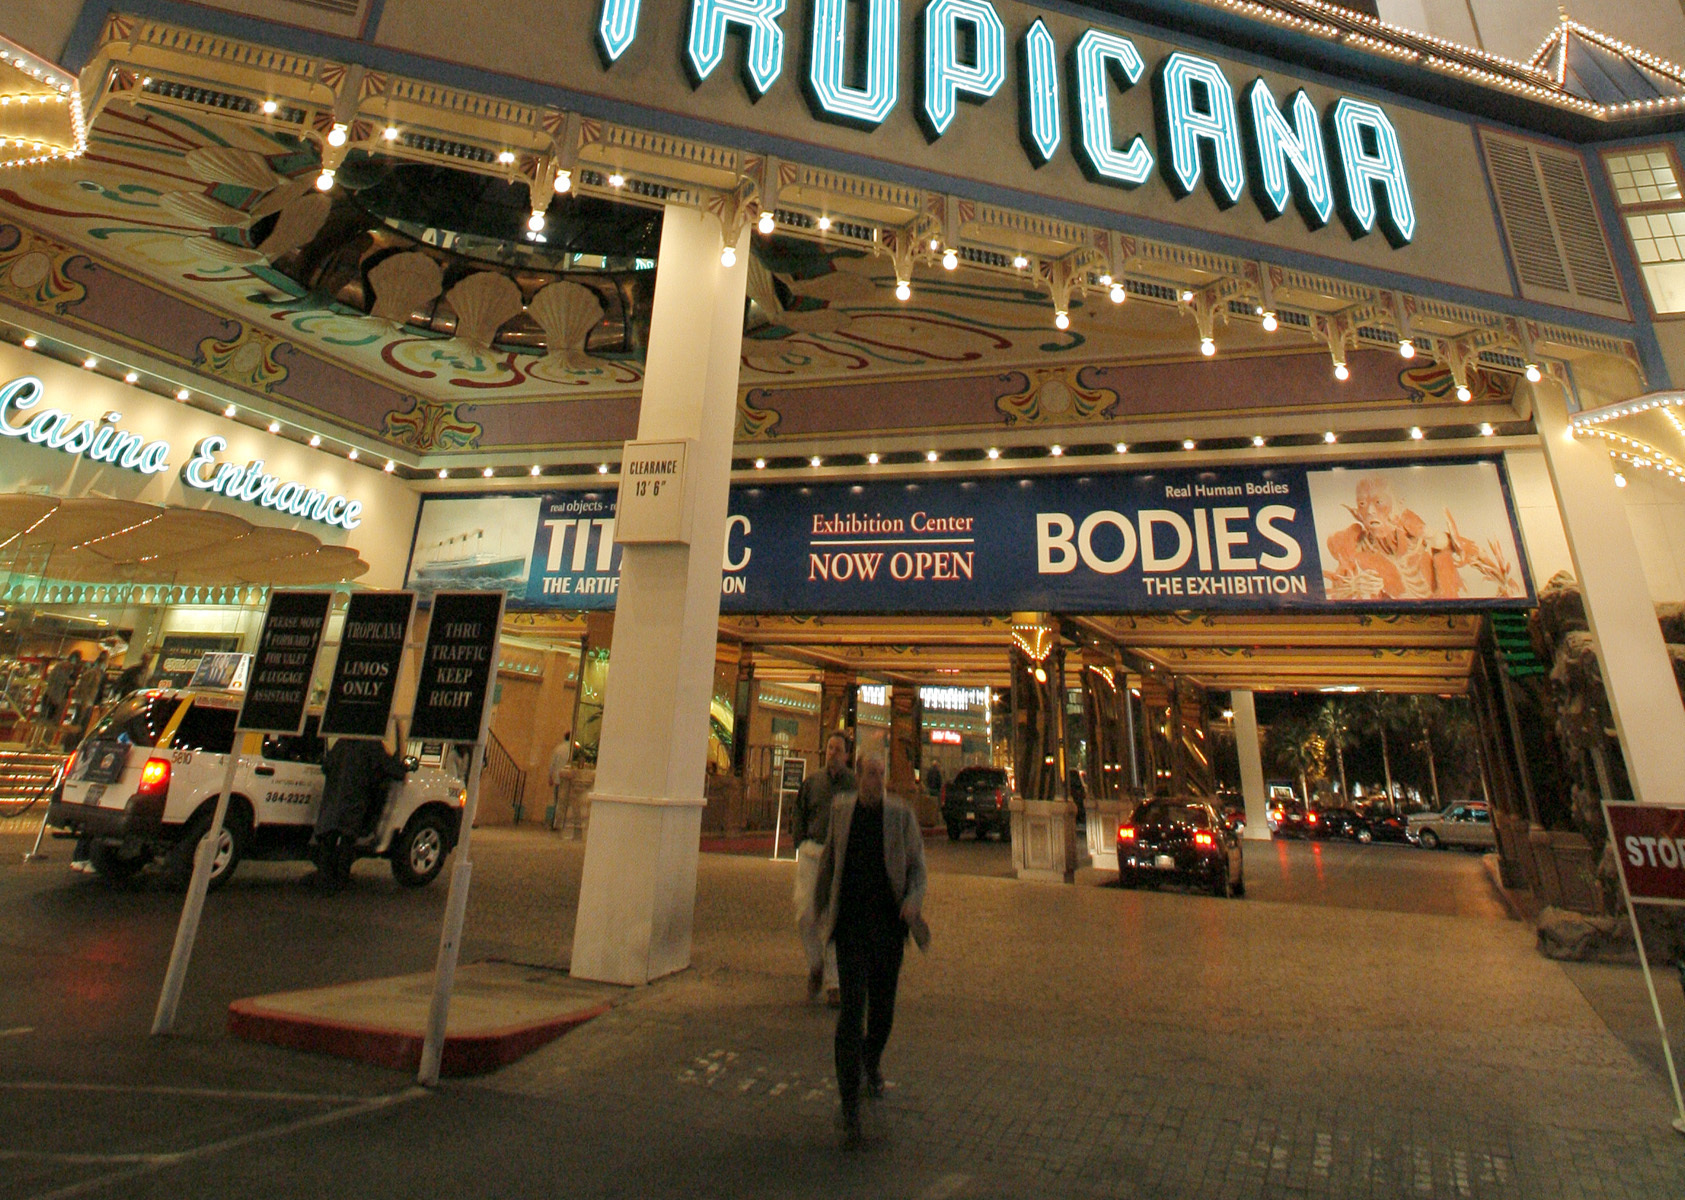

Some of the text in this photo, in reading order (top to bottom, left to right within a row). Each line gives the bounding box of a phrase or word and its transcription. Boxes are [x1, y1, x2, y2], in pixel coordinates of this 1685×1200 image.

[0, 375, 363, 530] Casino Entrance
[630, 460, 677, 475] CLEARANCE
[1165, 482, 1289, 498] Real Human Bodies
[550, 502, 566, 513] real
[566, 500, 603, 515] objects
[811, 511, 974, 535] Exhibition Center
[1036, 504, 1302, 574] BODIES
[808, 550, 975, 582] NOW OPEN
[543, 577, 572, 594] THE
[1143, 575, 1308, 595] THE EXHIBITION
[347, 622, 402, 639] TROPICANA
[445, 622, 480, 638] THRU
[432, 645, 486, 660] TRAFFIC
[344, 661, 389, 676] LIMOS
[437, 668, 472, 684] KEEP
[343, 681, 383, 696] ONLY
[430, 691, 472, 707] RIGHT
